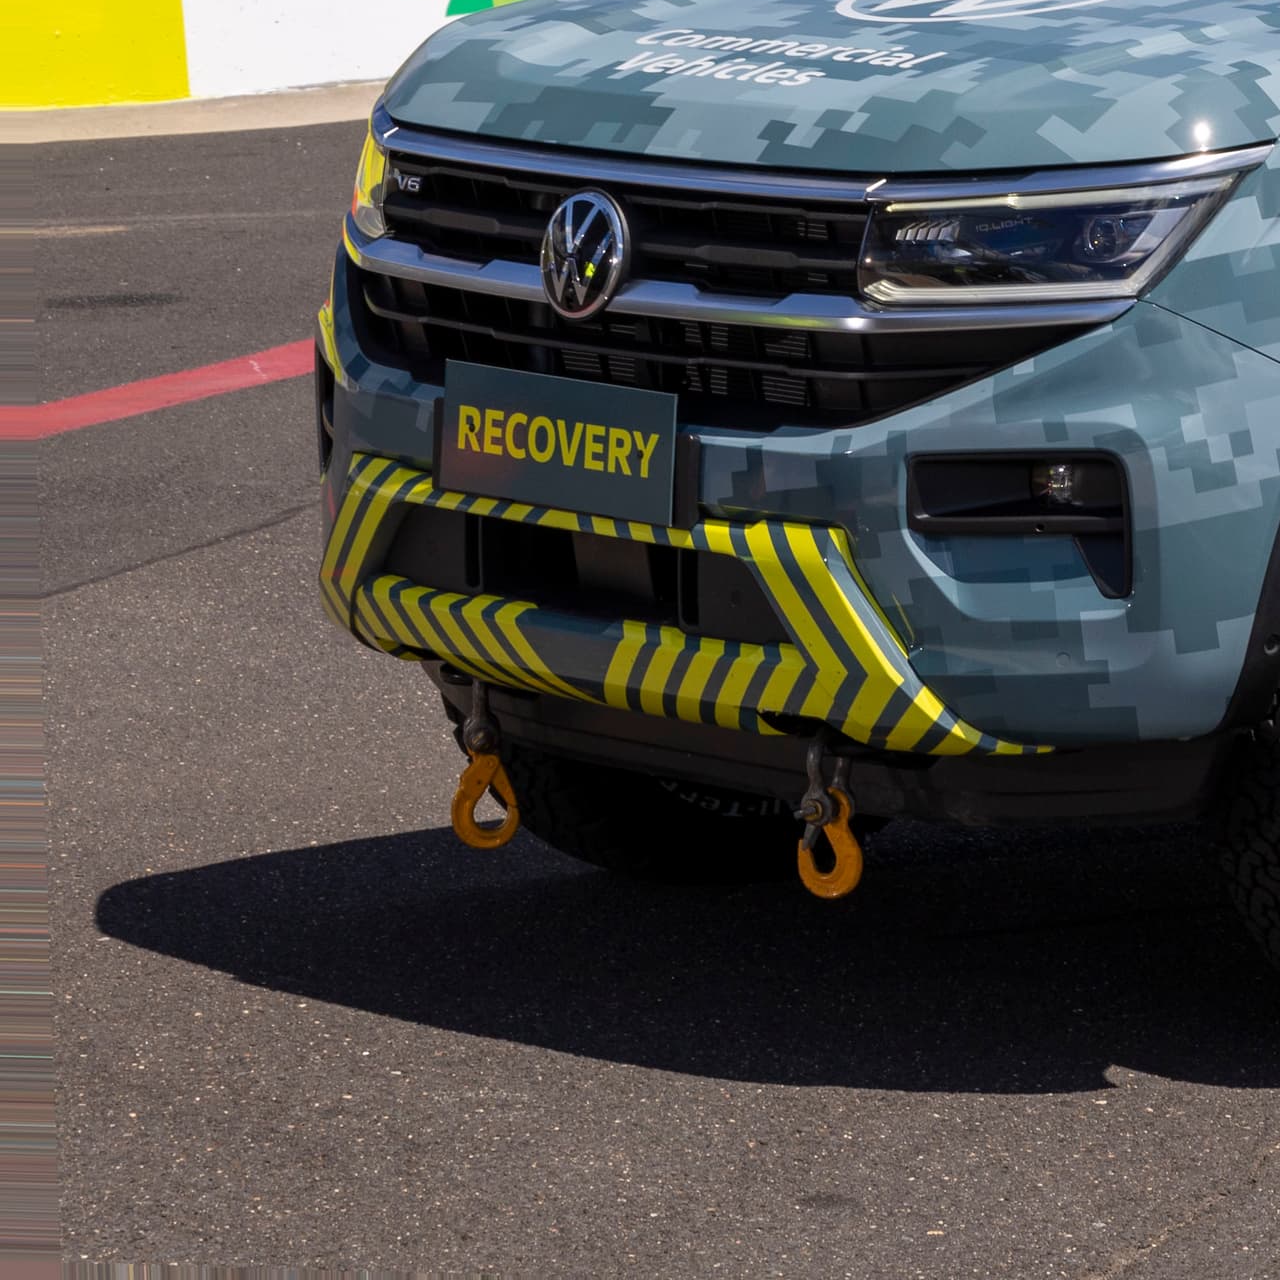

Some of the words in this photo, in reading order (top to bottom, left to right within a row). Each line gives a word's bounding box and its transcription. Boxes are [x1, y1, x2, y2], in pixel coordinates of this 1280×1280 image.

[614, 51, 826, 88] Vehicles
[635, 28, 947, 70] Commercial
[457, 404, 660, 479] RECOVERY
